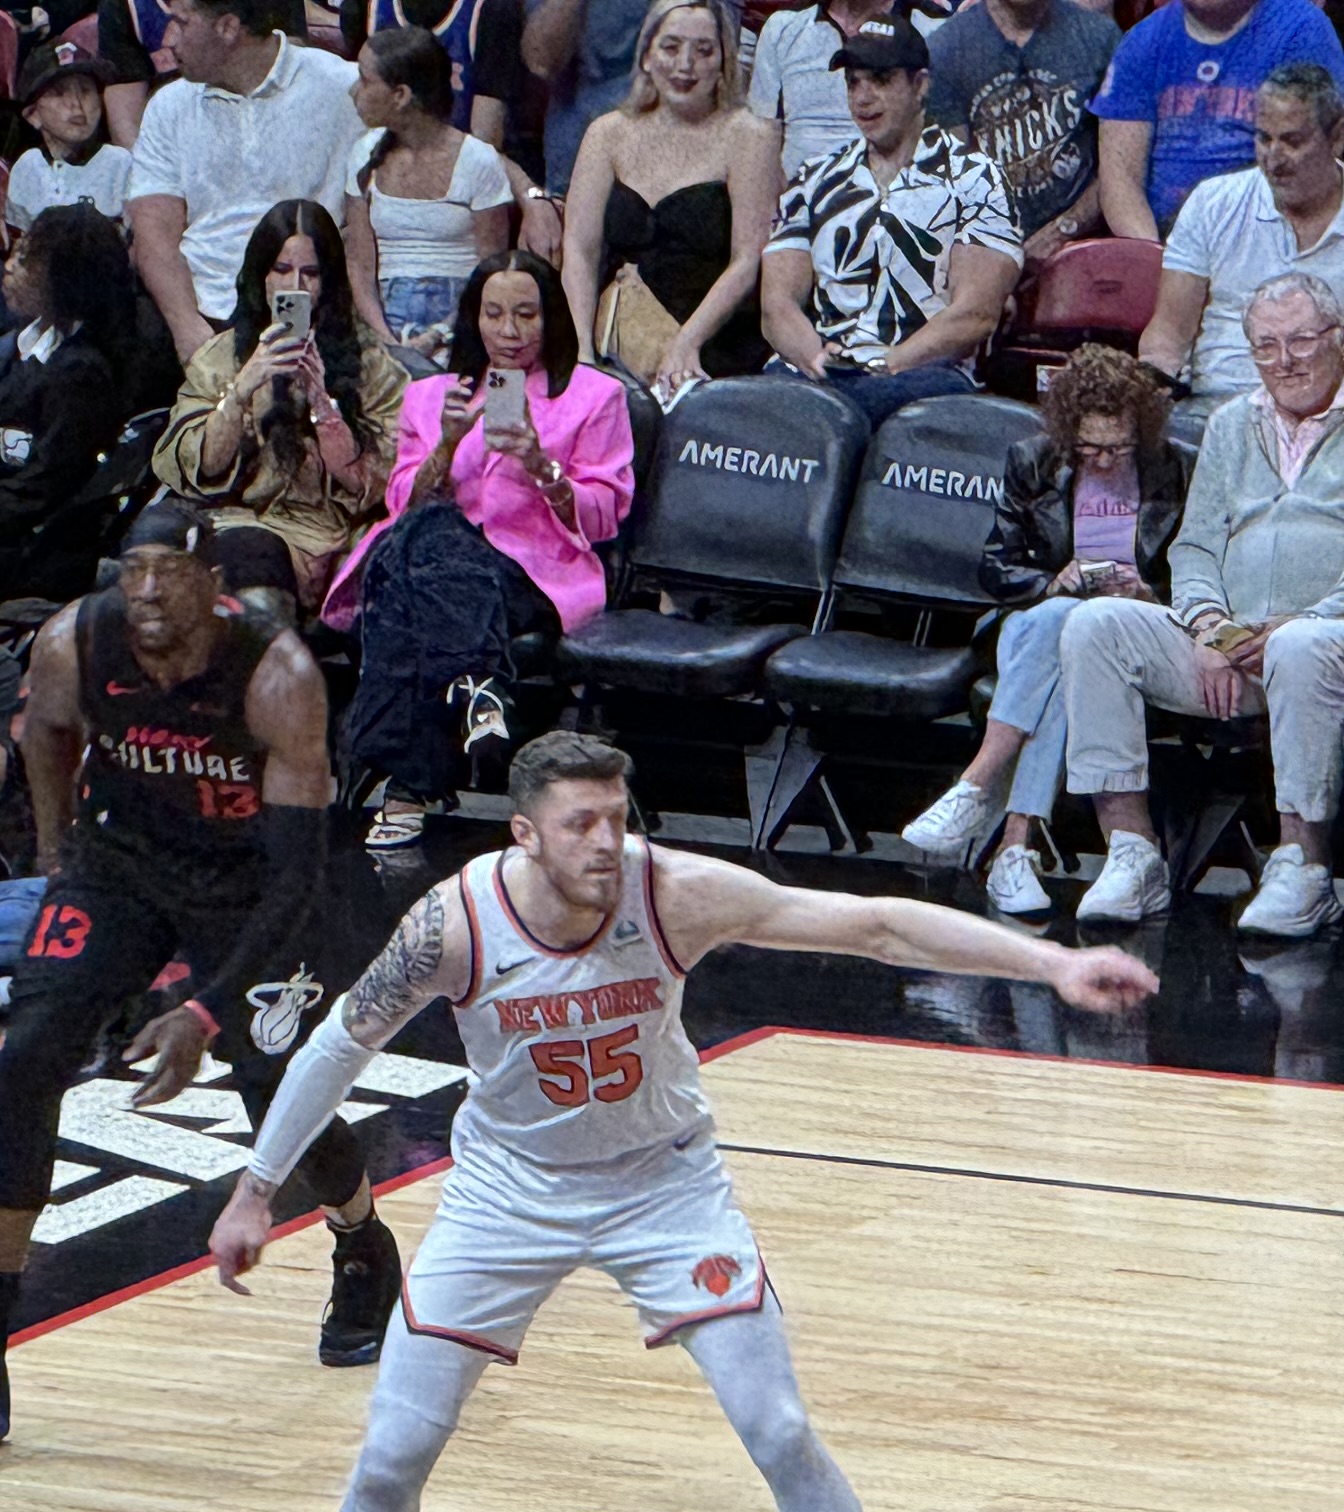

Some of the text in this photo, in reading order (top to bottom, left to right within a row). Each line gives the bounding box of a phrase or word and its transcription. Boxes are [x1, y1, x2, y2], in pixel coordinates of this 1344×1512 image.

[678, 439, 820, 484] AMERANT
[196, 779, 260, 819] 13
[26, 903, 93, 960] 13
[528, 1023, 644, 1108] 55
